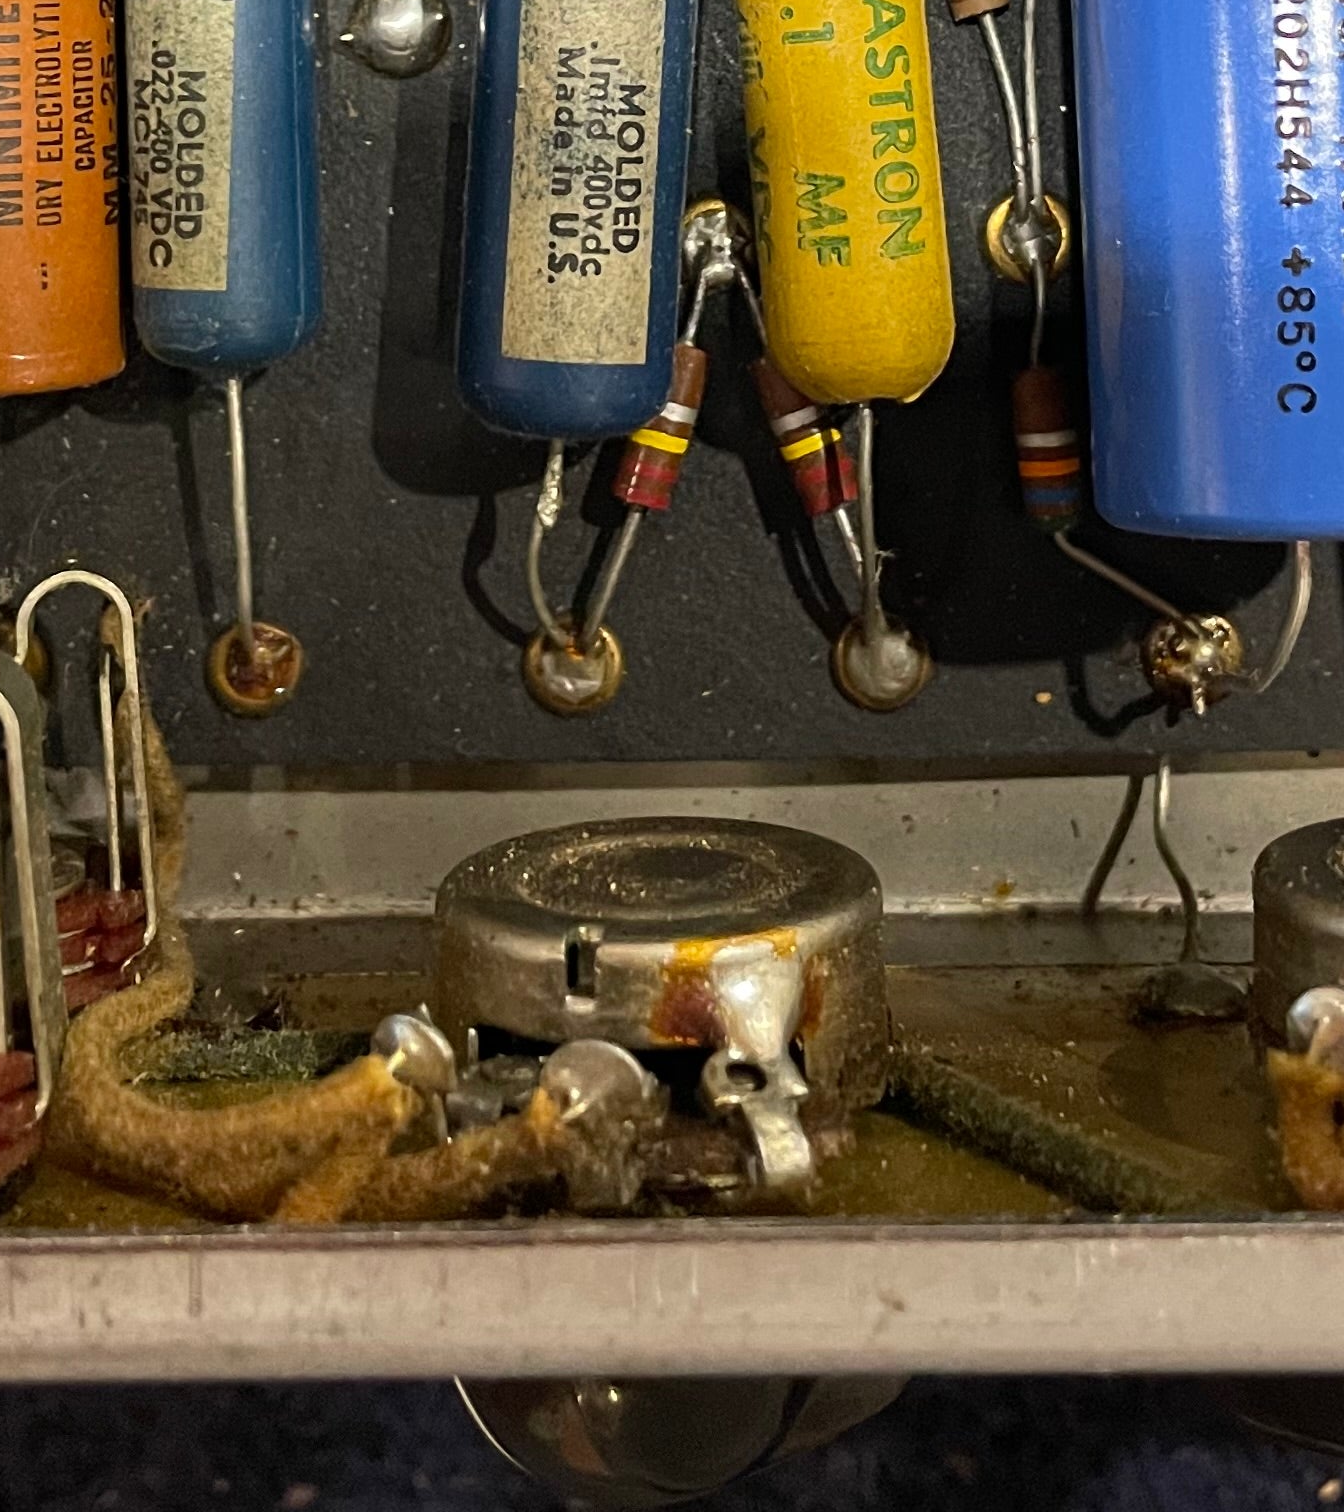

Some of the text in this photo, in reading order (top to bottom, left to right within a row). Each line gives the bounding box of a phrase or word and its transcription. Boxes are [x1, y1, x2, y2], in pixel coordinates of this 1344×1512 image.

[72, 40, 95, 172] CAPACITOR
[176, 70, 206, 238] MOLDED
[547, 46, 584, 284] Made in U.S.
[612, 82, 646, 252] MOLDED
[780, 6, 851, 267] .1 MF
[34, 178, 61, 227] DRY
[148, 185, 171, 267] VDC
[577, 155, 614, 278] 400vdc
